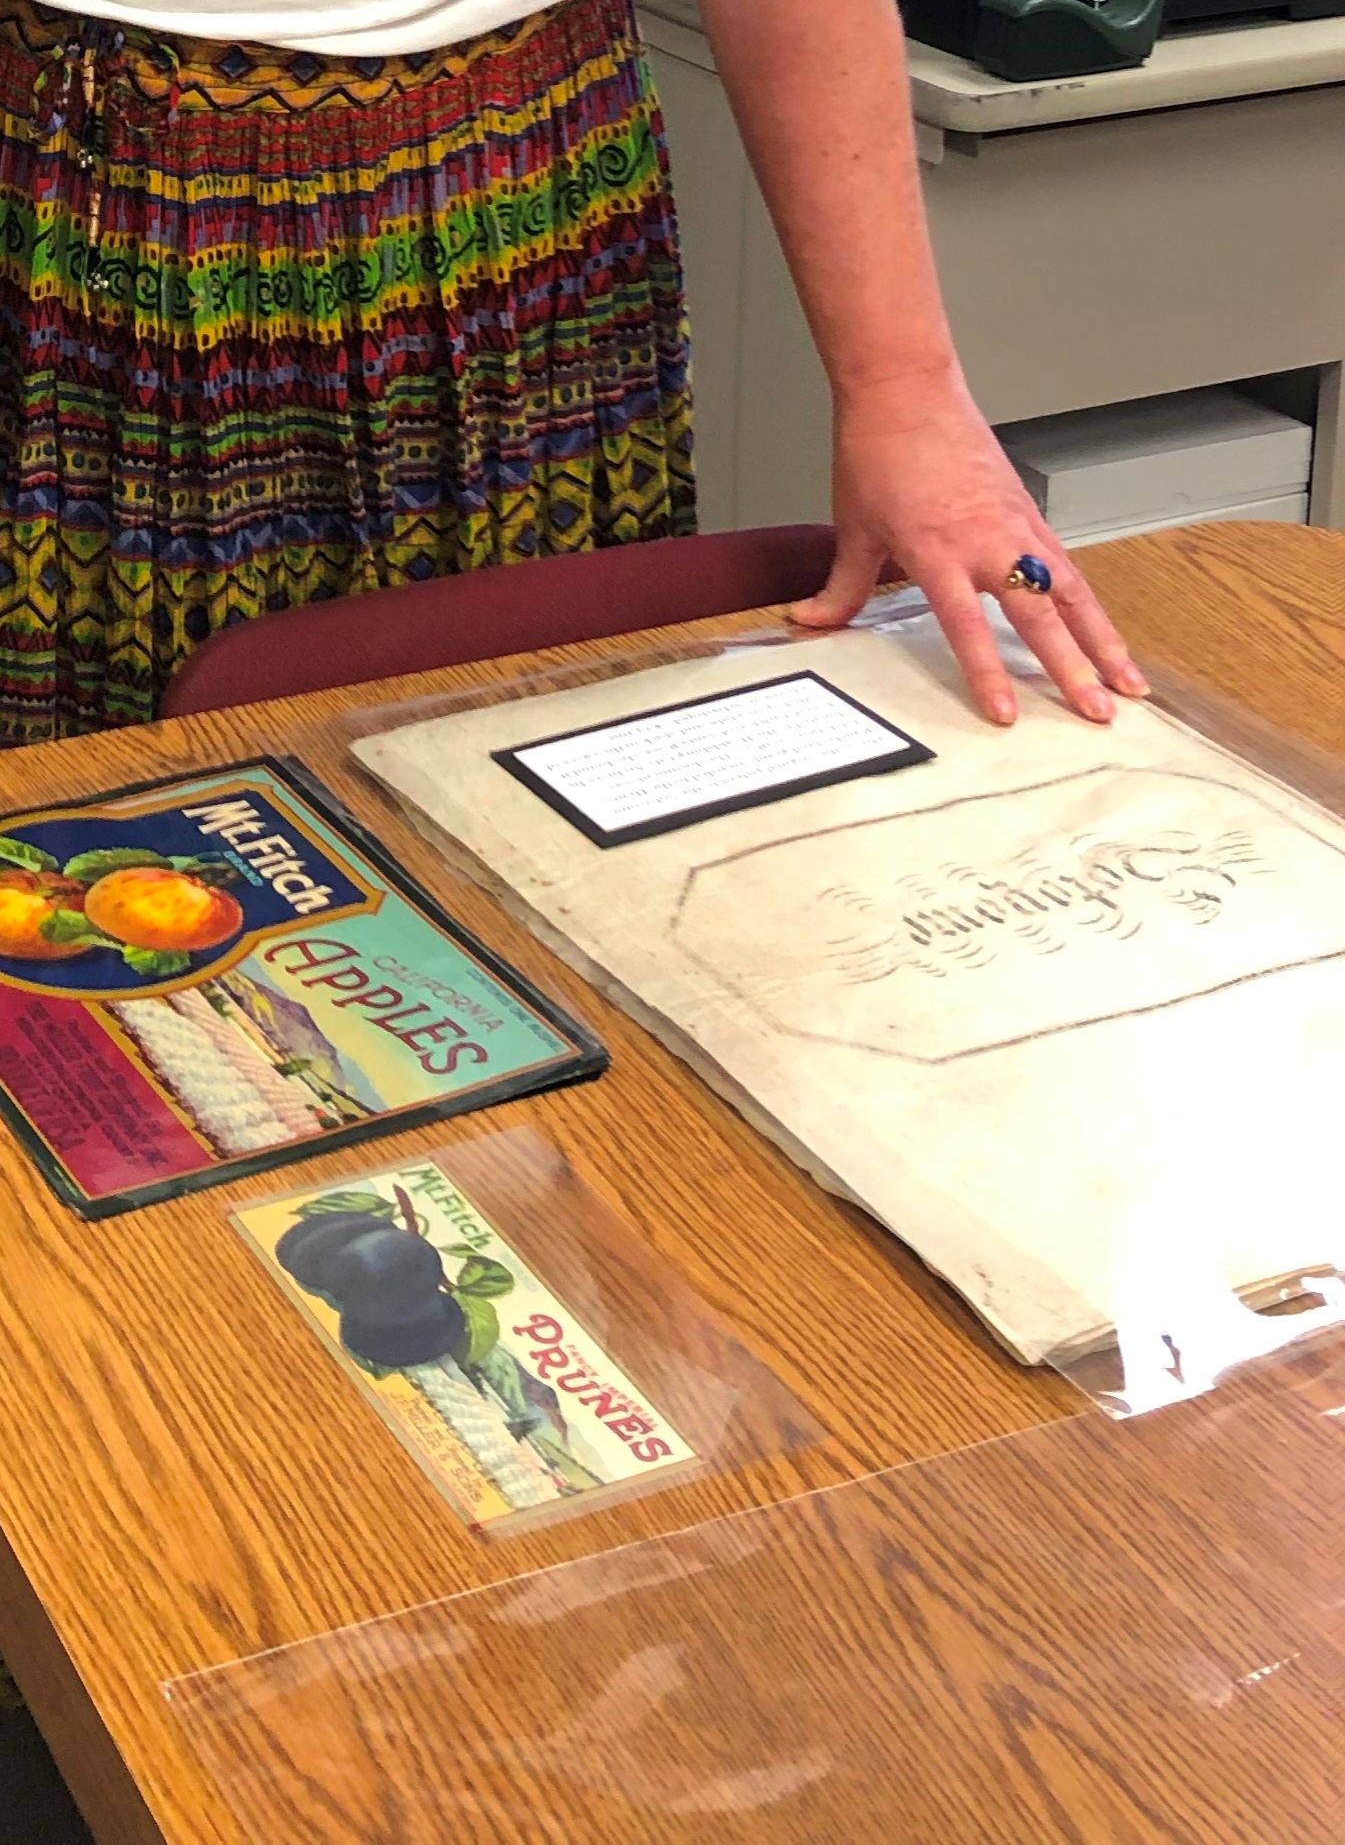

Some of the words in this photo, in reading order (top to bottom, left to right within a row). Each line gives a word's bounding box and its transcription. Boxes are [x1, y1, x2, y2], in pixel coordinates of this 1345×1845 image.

[263, 938, 488, 1076] APPLES
[372, 954, 504, 1034] CALIFORNIA
[512, 1313, 674, 1463] PRUNES
